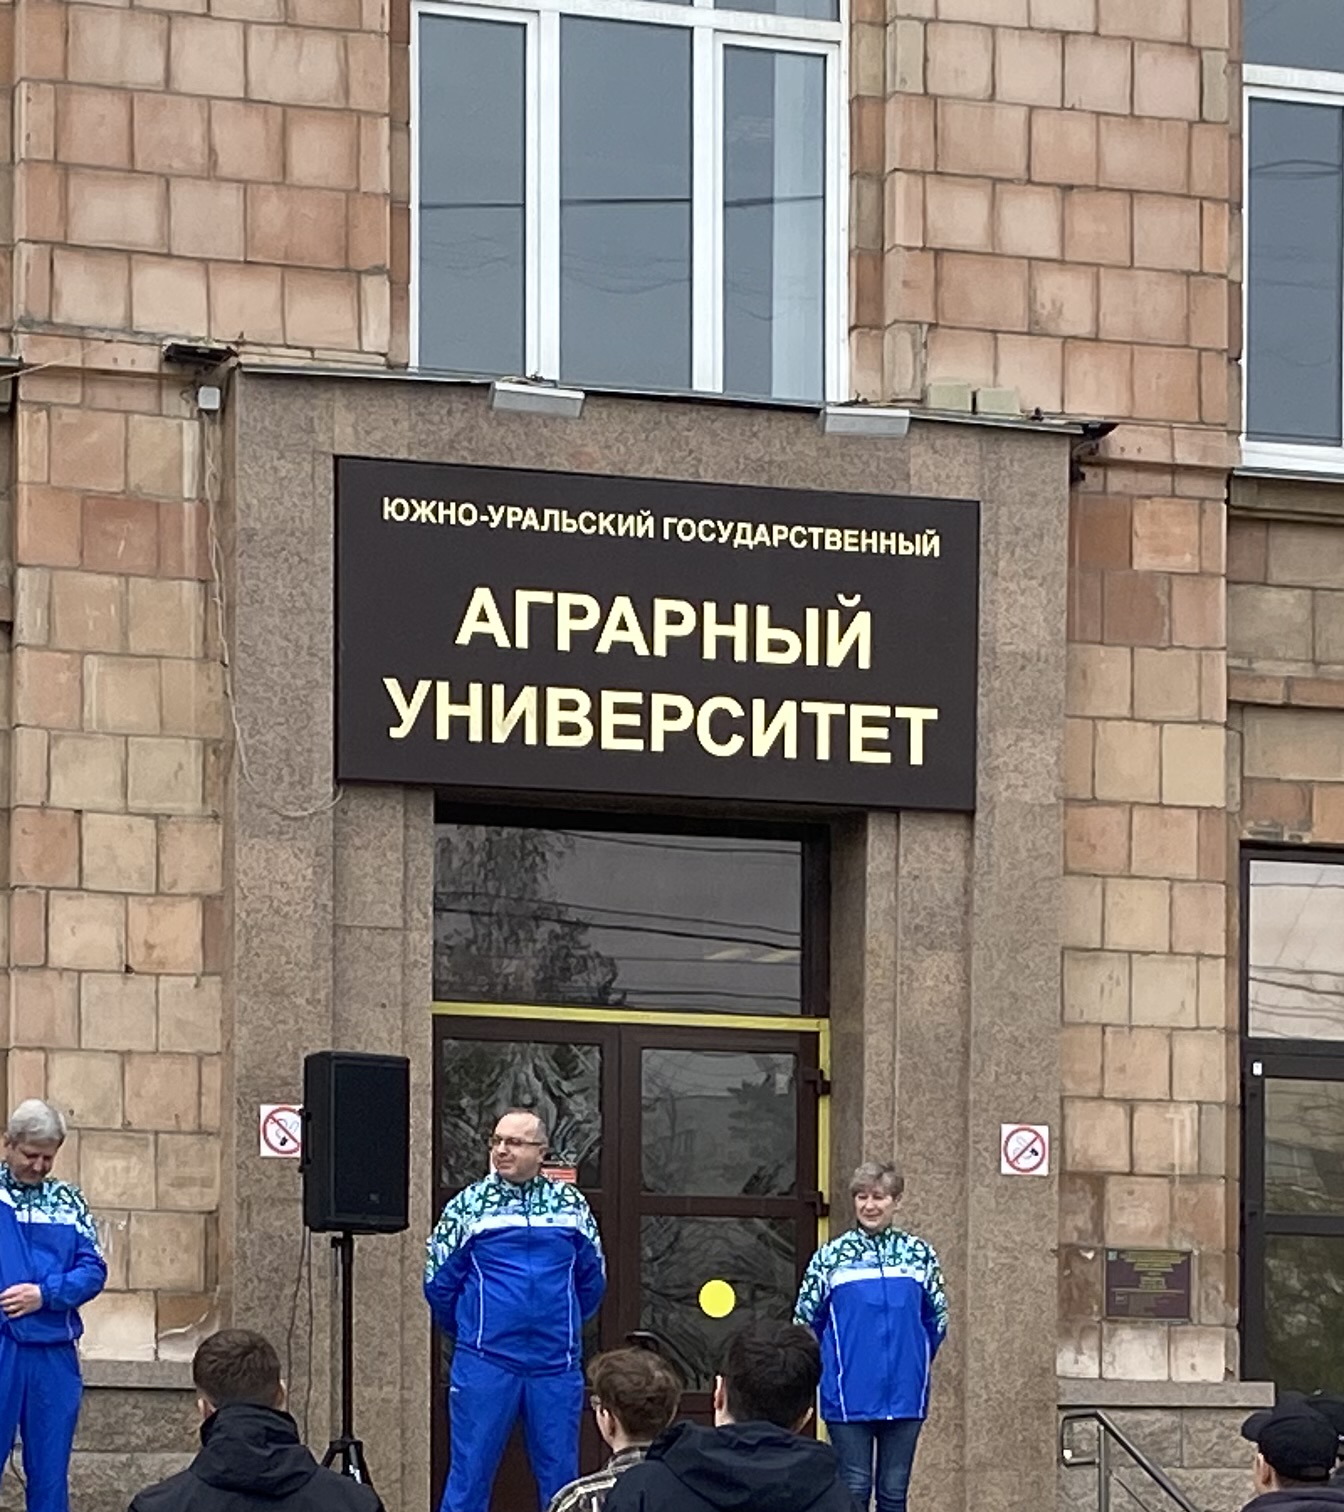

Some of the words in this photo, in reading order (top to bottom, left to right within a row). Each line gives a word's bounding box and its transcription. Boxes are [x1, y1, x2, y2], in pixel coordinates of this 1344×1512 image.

[381, 496, 655, 539] ЮЖНО-УРАЛЬСКИЙ
[662, 516, 941, 559] ГОСУДАРСТВЕННЫЙ
[454, 586, 872, 670] АГРАРНЫЙ
[382, 677, 939, 766] УНИВЕРСИТЕТ
